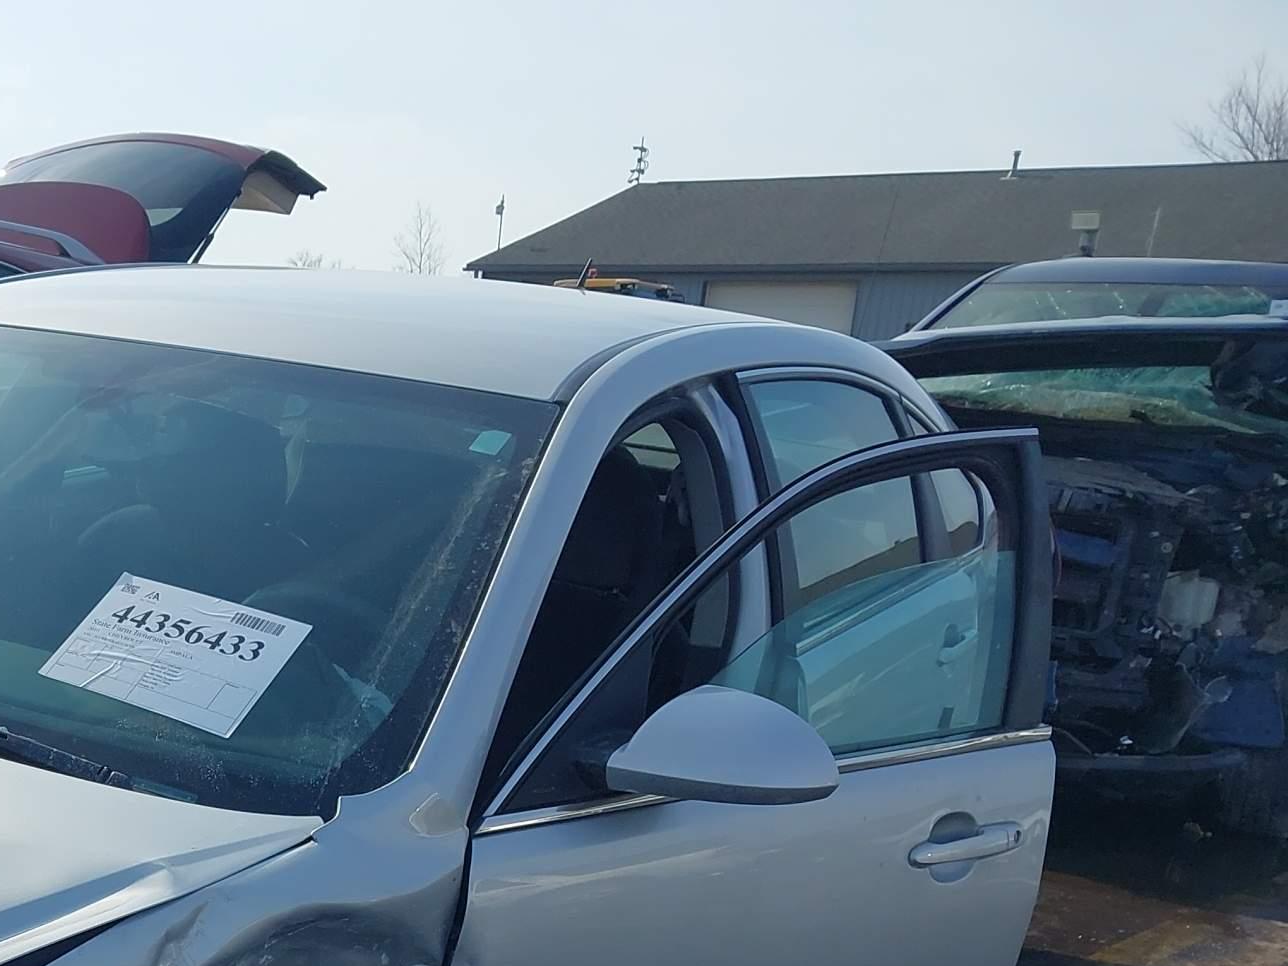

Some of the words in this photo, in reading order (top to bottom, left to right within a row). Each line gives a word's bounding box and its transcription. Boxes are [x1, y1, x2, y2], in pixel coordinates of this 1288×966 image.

[91, 619, 111, 629] State
[112, 623, 132, 634] Farm
[112, 605, 265, 662] 44356433
